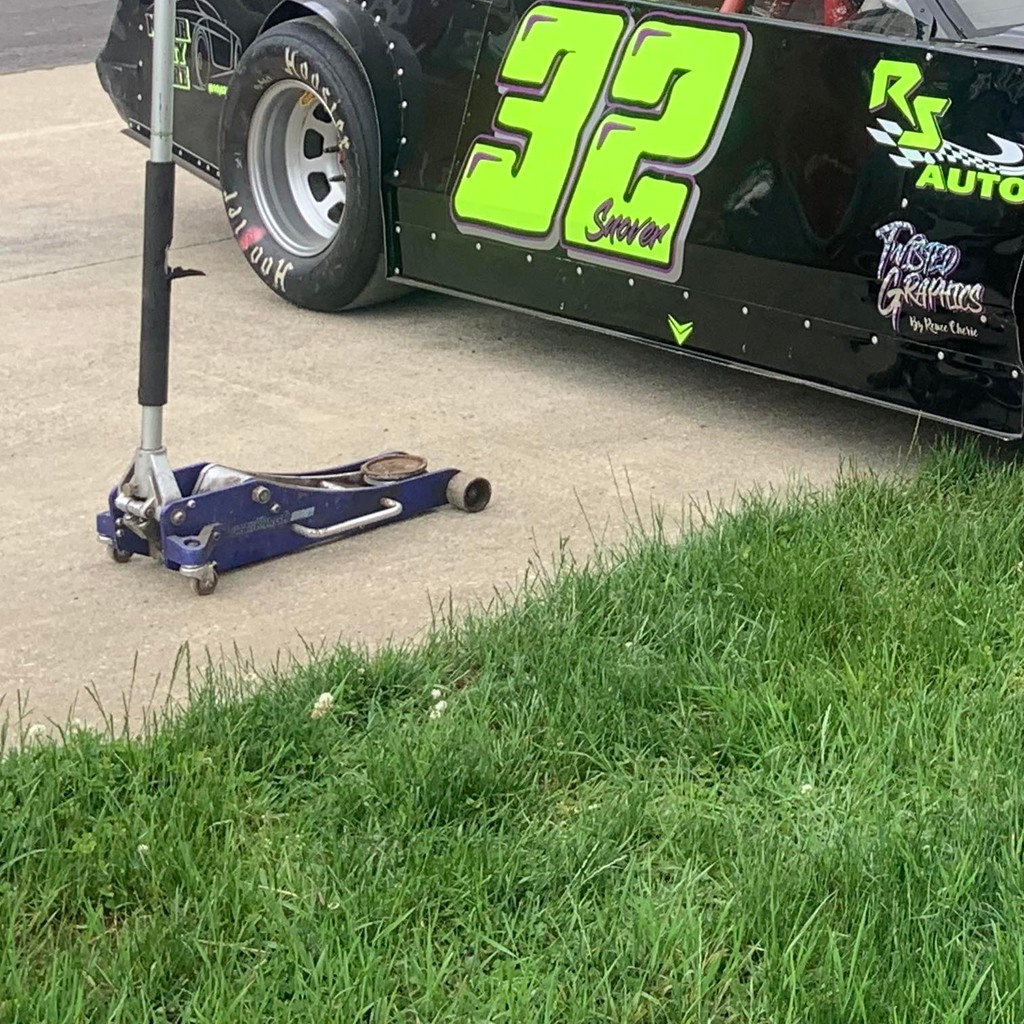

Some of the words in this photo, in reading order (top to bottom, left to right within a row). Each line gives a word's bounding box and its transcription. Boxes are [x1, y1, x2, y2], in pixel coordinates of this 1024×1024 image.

[868, 59, 952, 152] RS
[223, 190, 294, 292] Hooier
[584, 198, 671, 250] Snover
